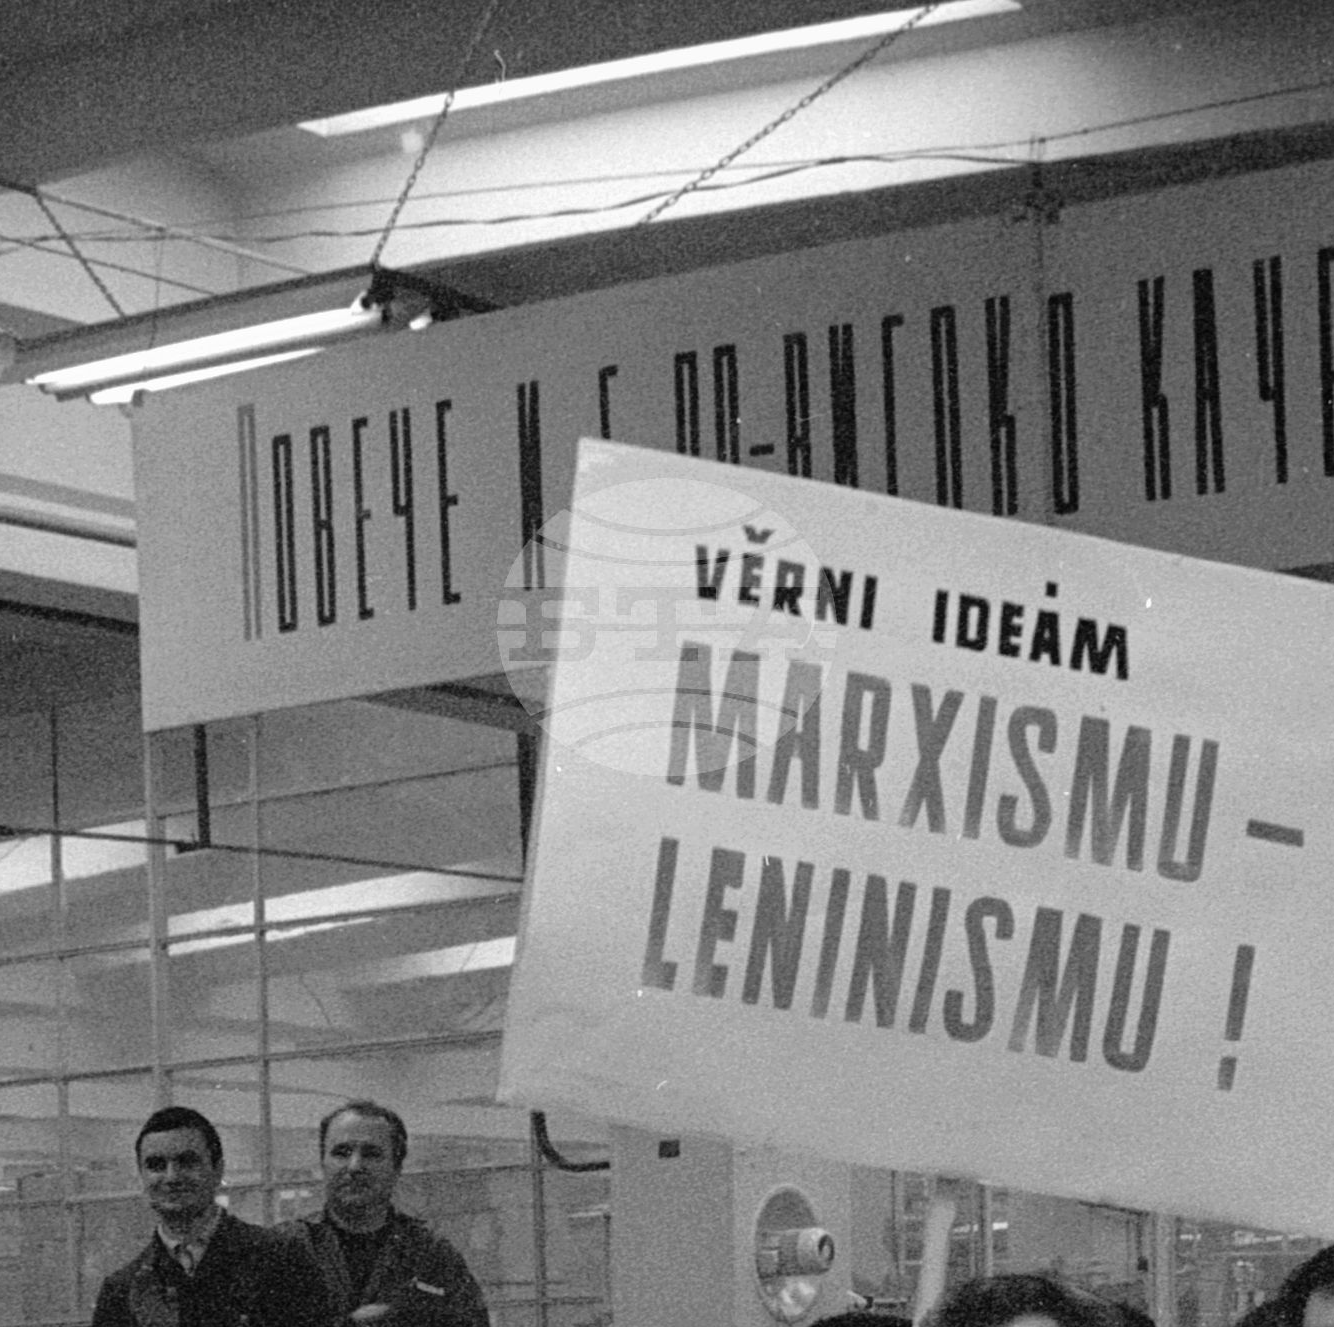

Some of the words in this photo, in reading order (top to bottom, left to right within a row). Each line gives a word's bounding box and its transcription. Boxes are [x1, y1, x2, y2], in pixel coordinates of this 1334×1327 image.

[238, 400, 461, 642] ПОВЕЧЕ
[694, 524, 878, 630] VĚRNI
[931, 580, 1130, 681] IDEÁM
